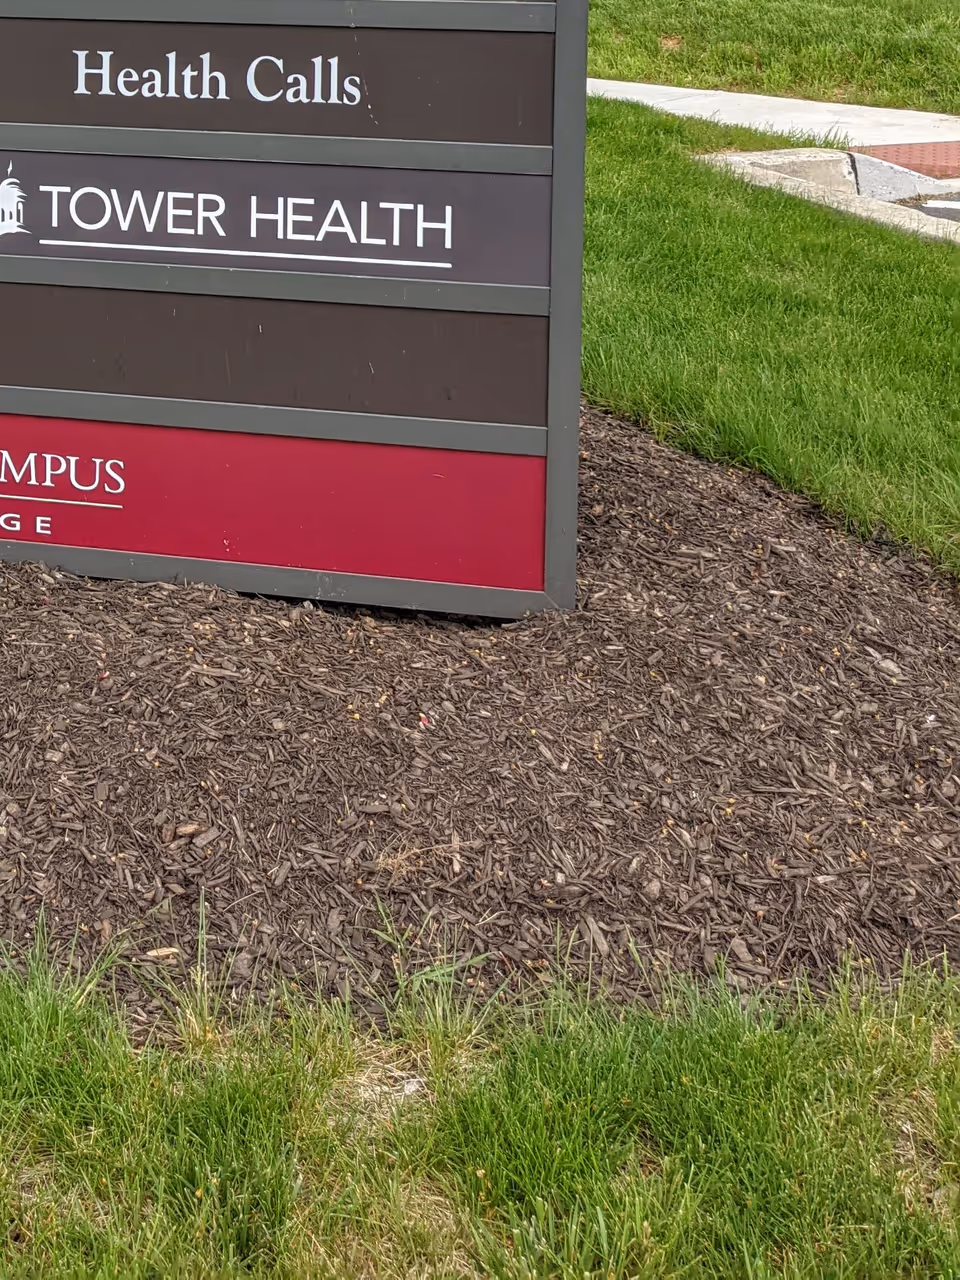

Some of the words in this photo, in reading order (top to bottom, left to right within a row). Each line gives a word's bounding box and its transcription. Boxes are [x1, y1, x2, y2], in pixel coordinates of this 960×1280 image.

[72, 49, 231, 100] Health
[246, 55, 362, 106] Calls
[38, 184, 227, 237] TOWER
[250, 195, 453, 250] HEALTH
